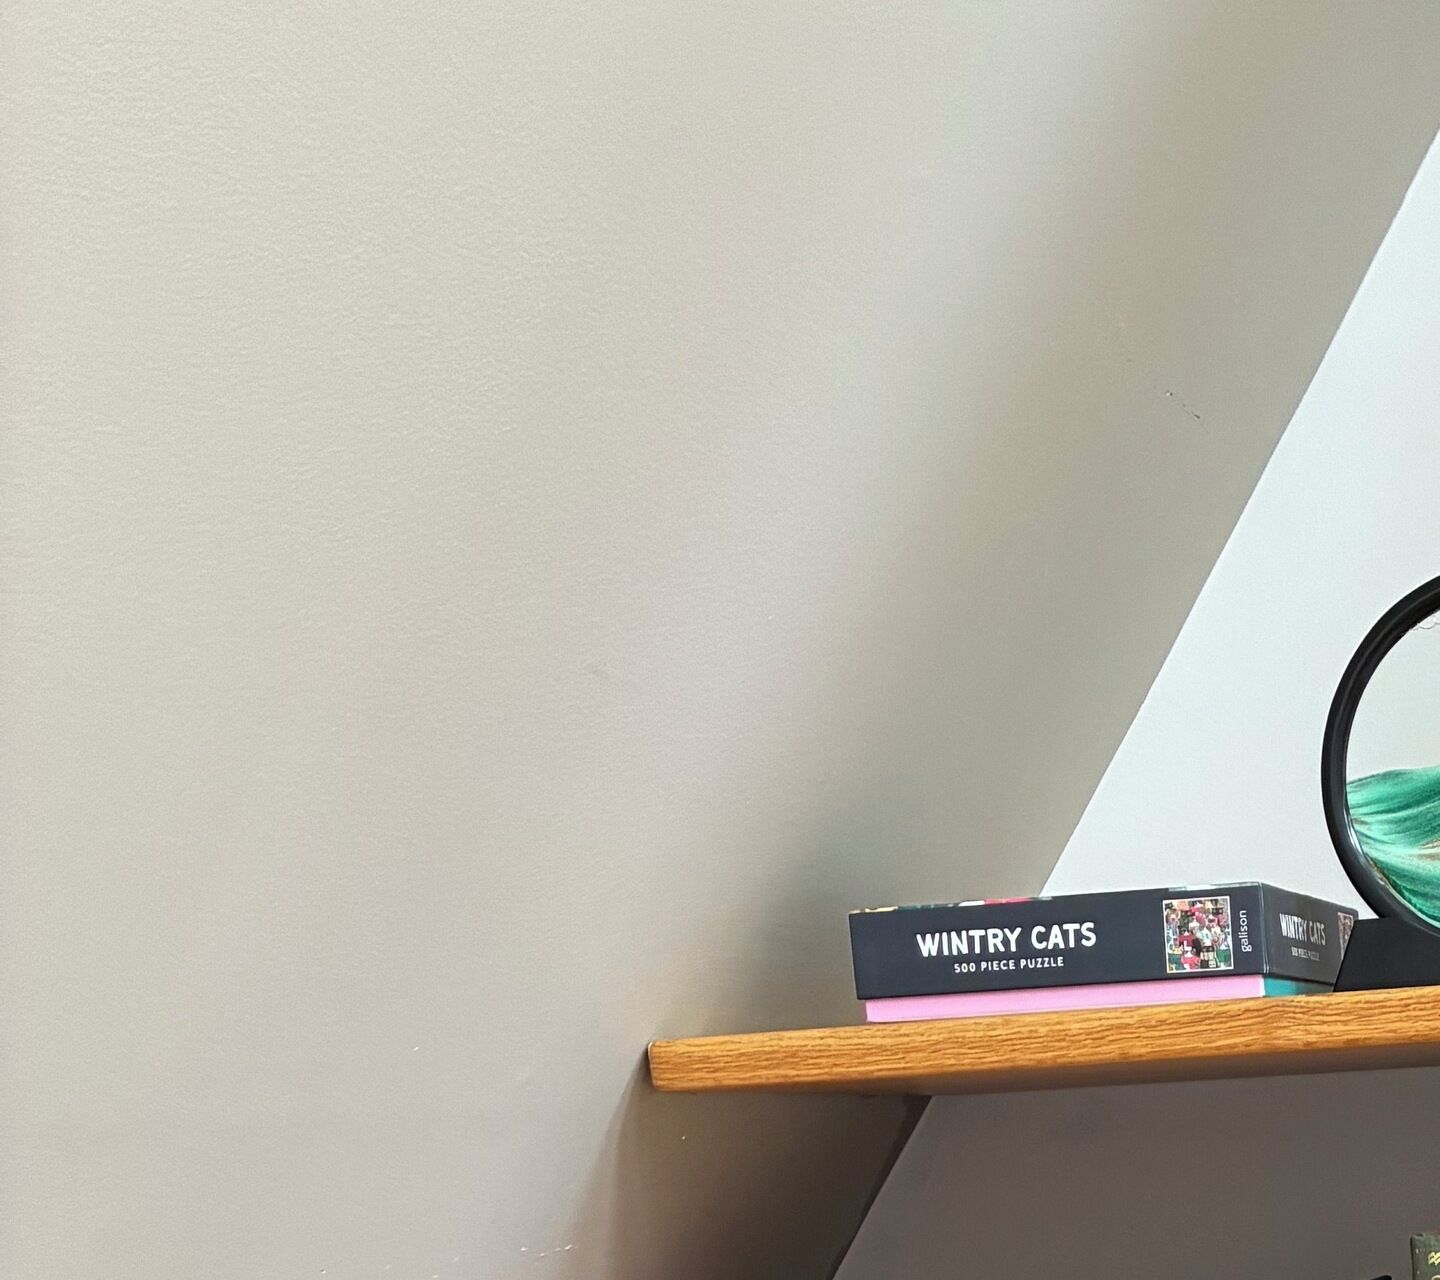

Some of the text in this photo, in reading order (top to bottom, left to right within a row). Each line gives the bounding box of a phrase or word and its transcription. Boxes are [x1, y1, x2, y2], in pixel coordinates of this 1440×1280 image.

[916, 922, 1096, 957] WINTRY CATS
[953, 956, 1064, 973] 500 PIECE PUZZLE
